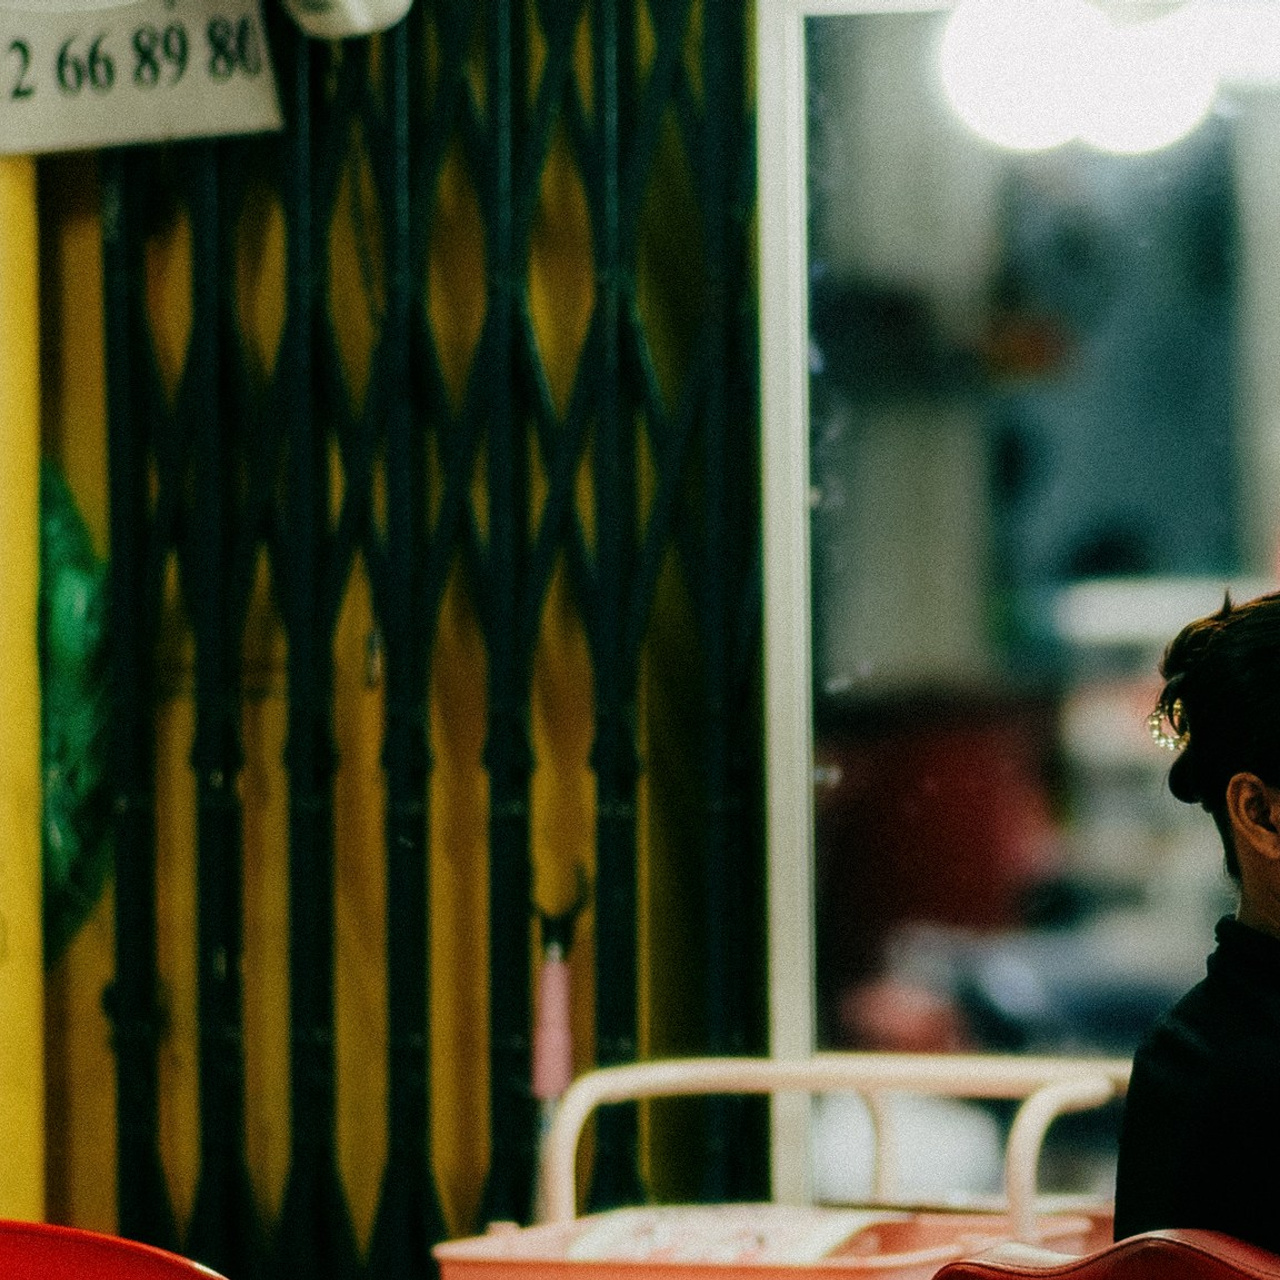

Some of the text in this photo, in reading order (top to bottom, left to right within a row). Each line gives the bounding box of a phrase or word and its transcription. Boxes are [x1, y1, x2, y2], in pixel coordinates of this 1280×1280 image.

[9, 38, 35, 100] 2
[55, 34, 116, 97] 66
[131, 22, 189, 90] 89
